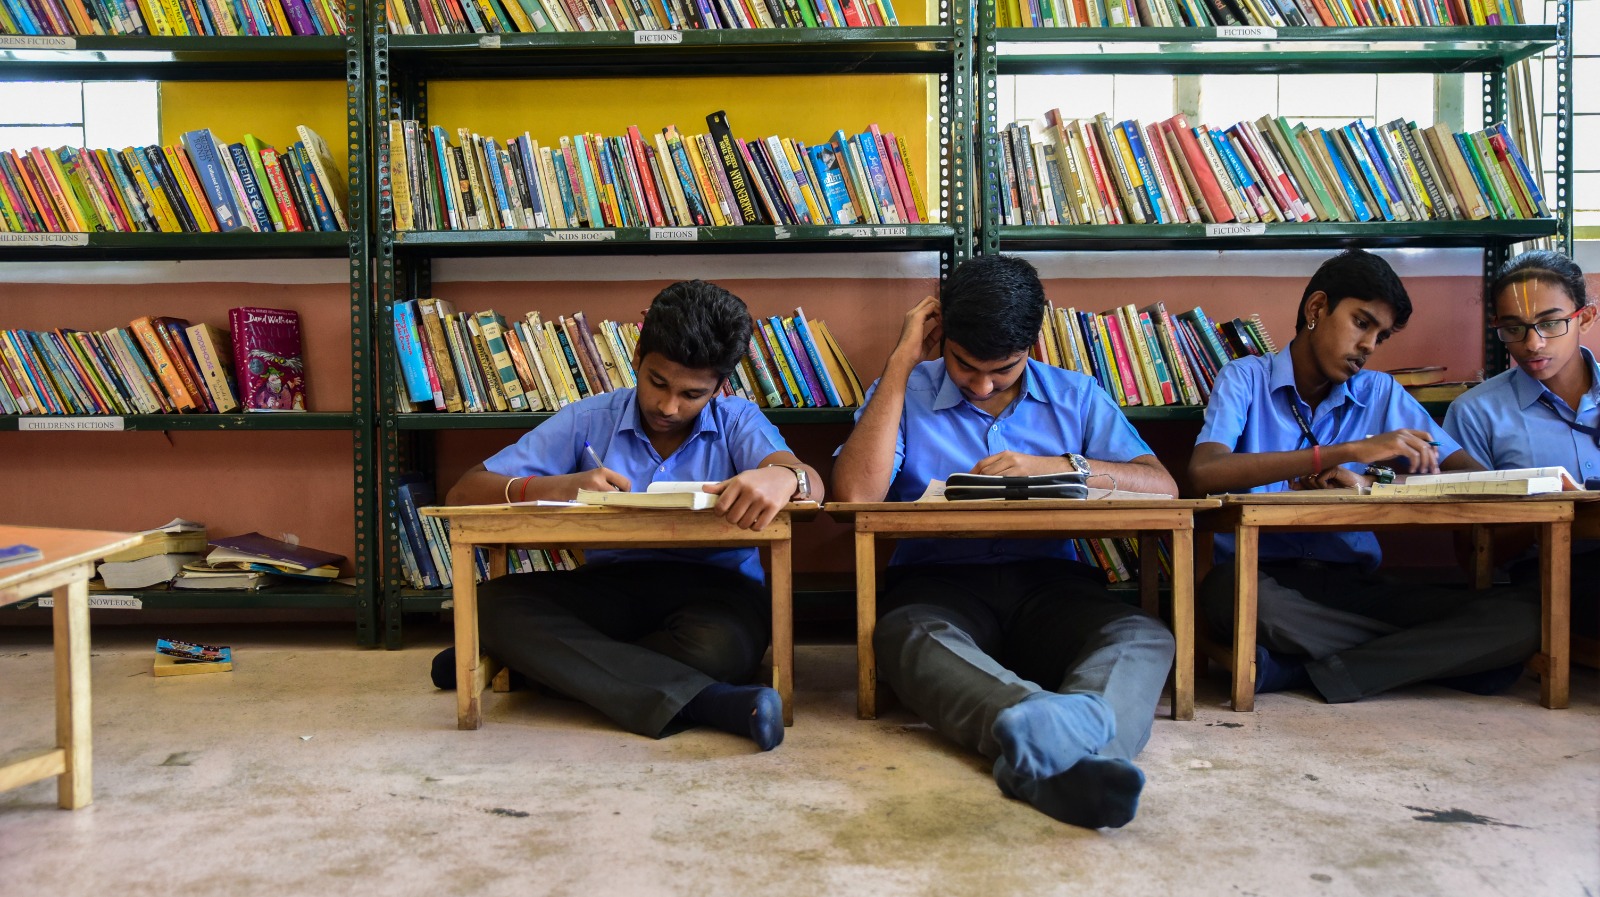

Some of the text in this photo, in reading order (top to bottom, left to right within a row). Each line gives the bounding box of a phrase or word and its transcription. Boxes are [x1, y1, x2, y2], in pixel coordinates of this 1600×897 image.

[194, 138, 207, 161] BOND
[199, 135, 214, 162] RUSKIN
[899, 137, 907, 157] CHETAN
[1201, 137, 1233, 192] YOU TOO CAN EXPORT
[1224, 147, 1247, 183] ACCOUNTANCY
[207, 164, 223, 201] Collected Fiction
[232, 147, 269, 226] ARTEMIS FOWL
[1138, 157, 1155, 196] oneness
[1400, 120, 1420, 159] POLITICS
[1416, 159, 1430, 178] AND
[1425, 177, 1448, 218] MARKETS
[730, 169, 755, 216] DARREN SHAN
[243, 313, 296, 324] David Walliams
[194, 328, 215, 370] WODEHOUSE
[558, 332, 577, 366] JACK HIGGINS
